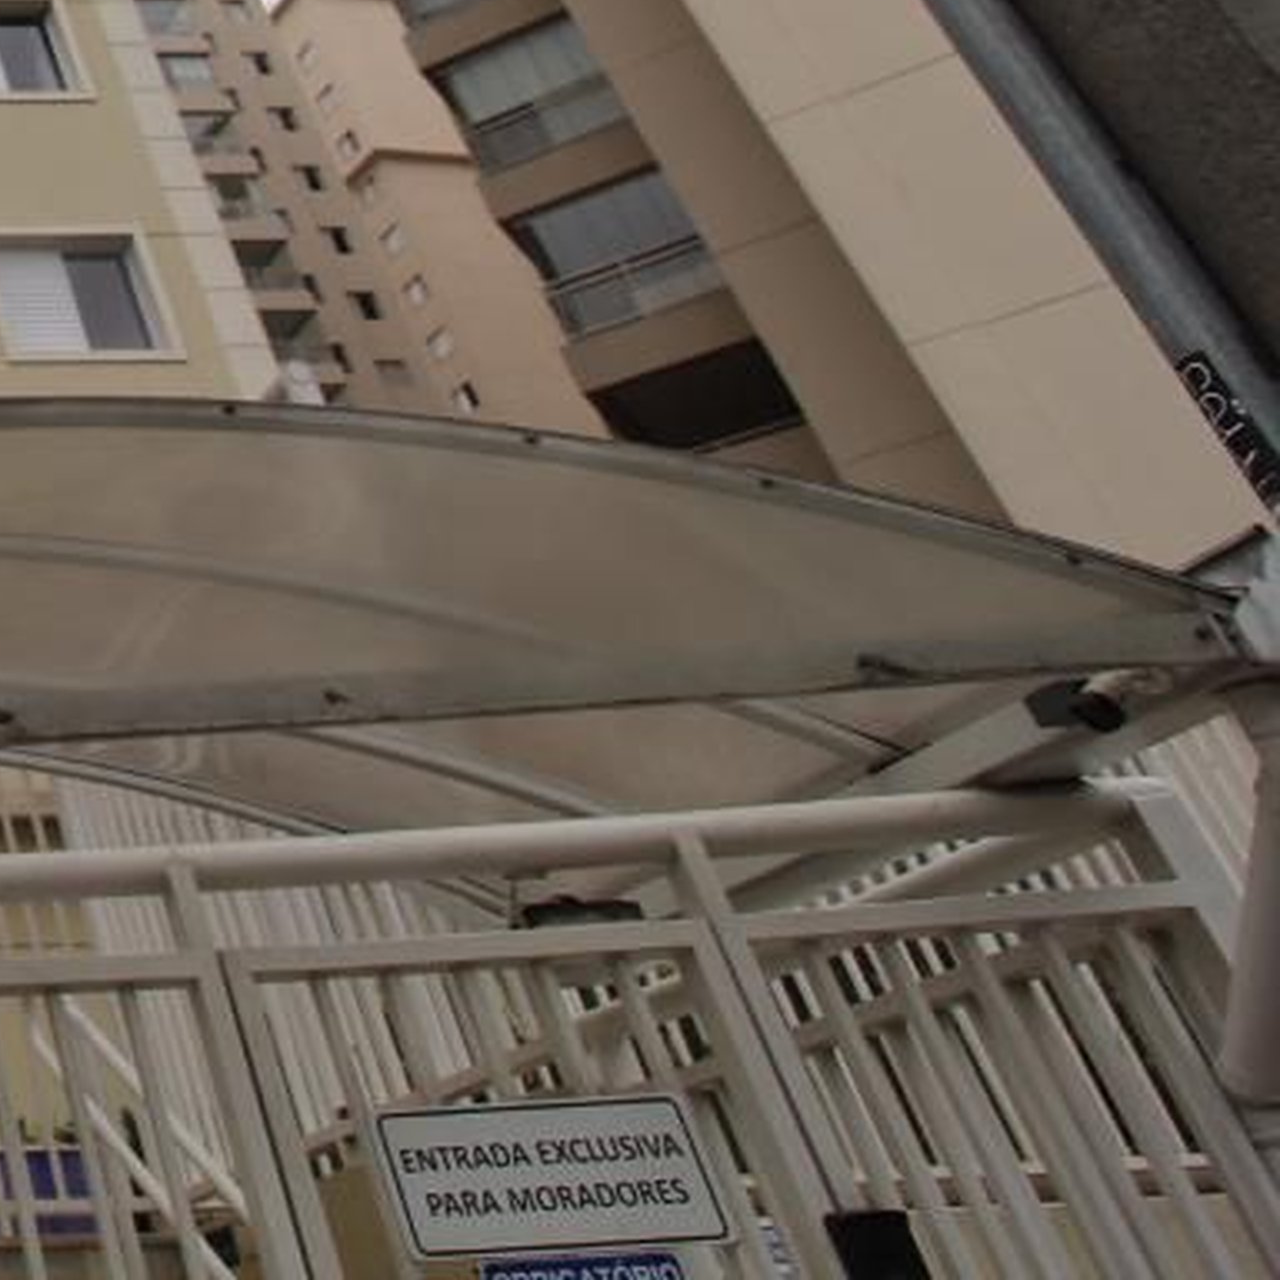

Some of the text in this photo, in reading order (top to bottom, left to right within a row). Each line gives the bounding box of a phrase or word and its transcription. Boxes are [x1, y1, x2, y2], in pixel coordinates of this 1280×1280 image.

[399, 1132, 685, 1175] ENTRADA EXCLUSIVA
[425, 1177, 691, 1218] PARA MORADORES
